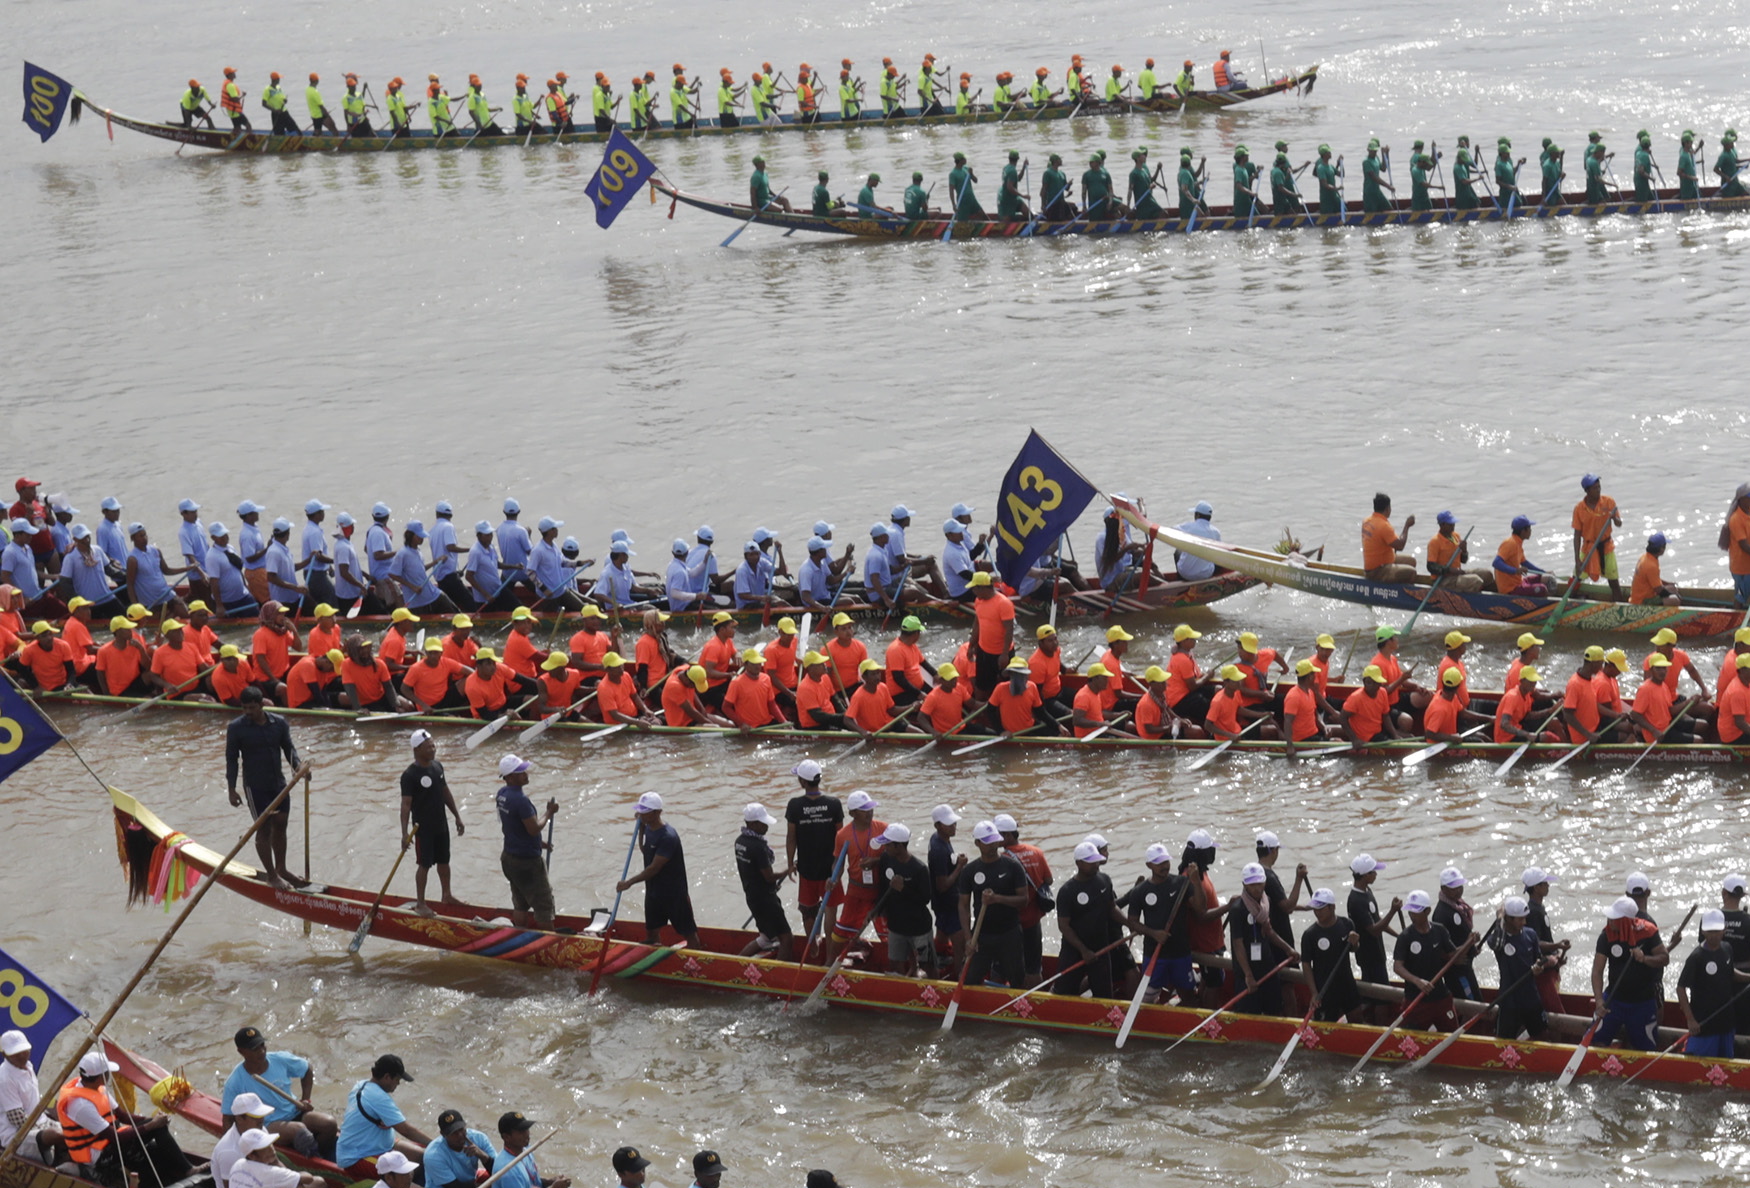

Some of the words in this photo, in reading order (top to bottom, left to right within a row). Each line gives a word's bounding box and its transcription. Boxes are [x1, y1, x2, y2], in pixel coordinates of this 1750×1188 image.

[30, 75, 60, 128] 100
[597, 149, 639, 207] 109
[997, 465, 1064, 554] 143
[0, 968, 50, 1052] 8
